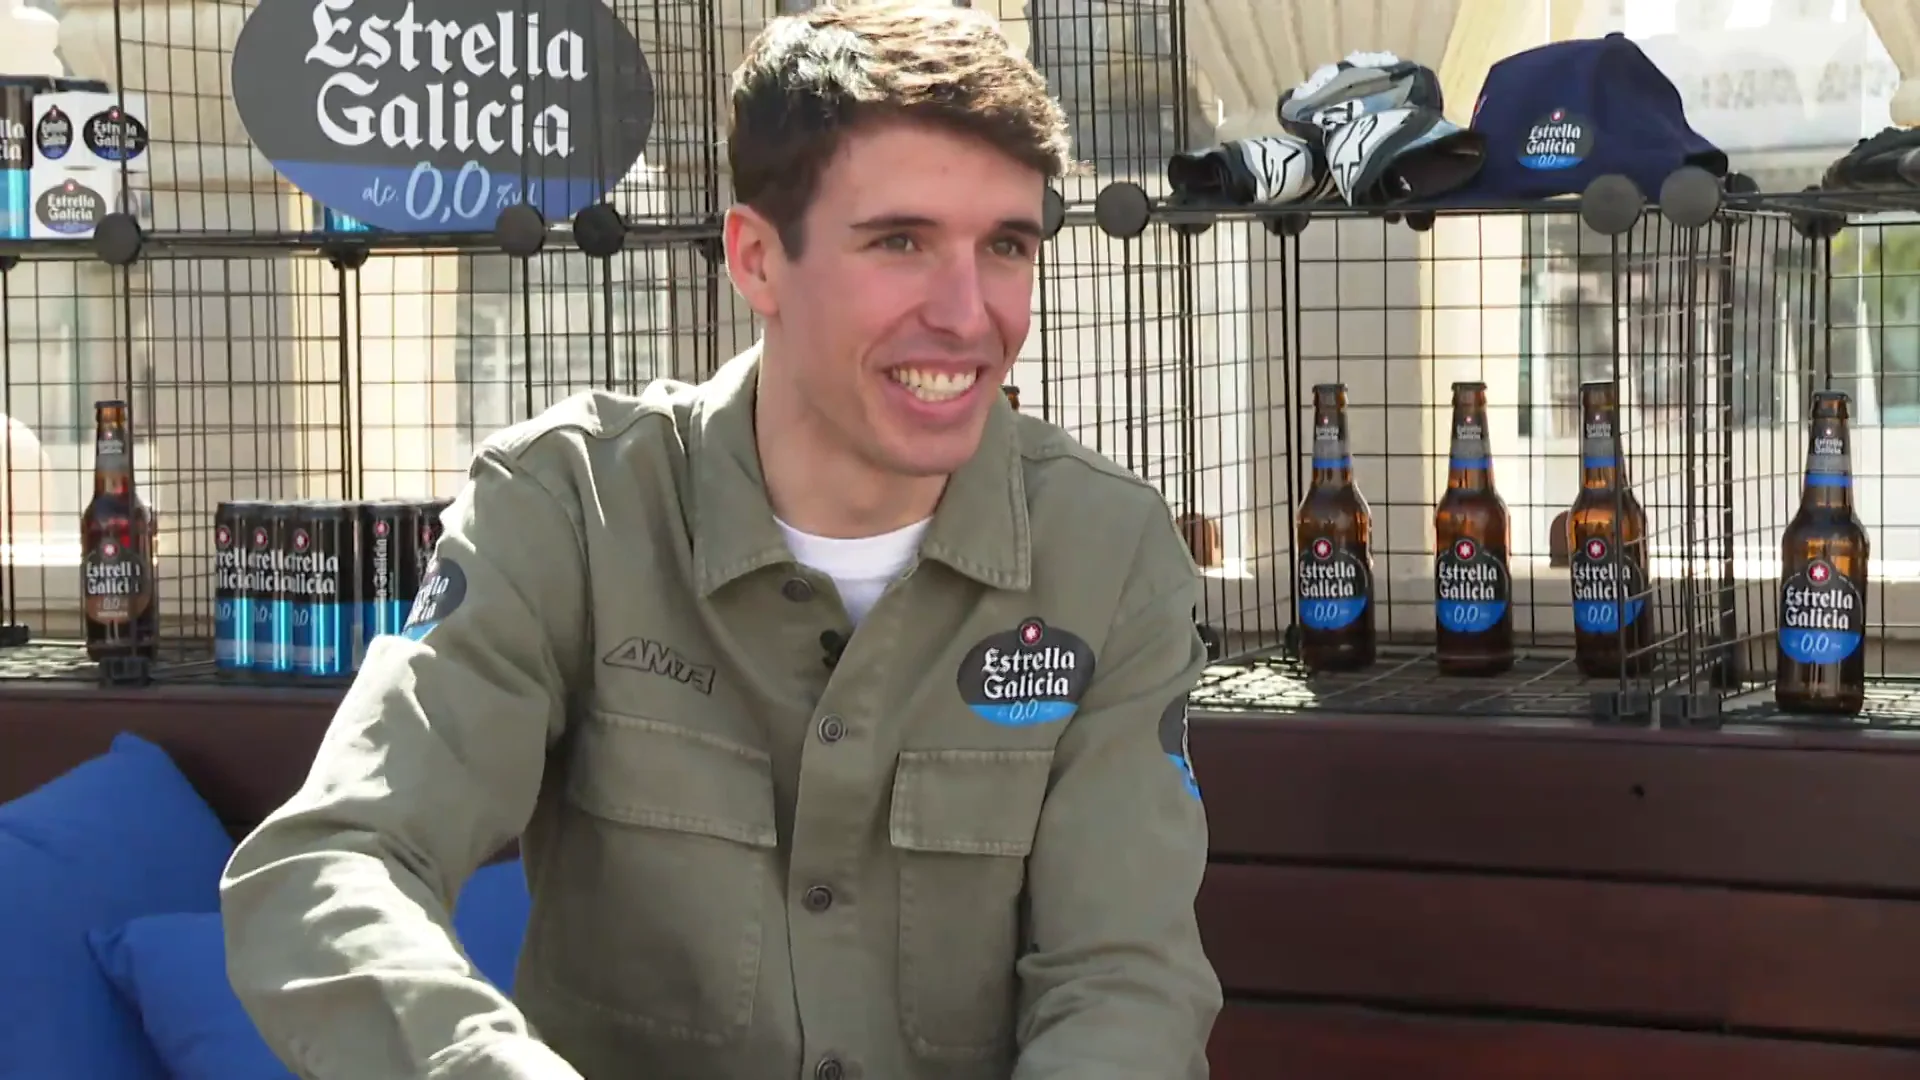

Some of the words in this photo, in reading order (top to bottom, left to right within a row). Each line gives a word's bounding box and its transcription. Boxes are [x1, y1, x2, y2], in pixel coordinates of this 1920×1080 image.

[304, 0, 588, 81] Estrella
[316, 72, 575, 158] Galicia
[1528, 123, 1581, 140] Estrella
[1526, 138, 1576, 155] Galicia
[1439, 560, 1498, 581] Estrella
[1301, 577, 1354, 598] Galicia
[1440, 578, 1495, 600] Galicia
[1785, 585, 1854, 610] Estrella
[1785, 606, 1850, 631] Galicia
[982, 647, 1076, 674] Estrella
[983, 671, 1069, 699] Galicia
